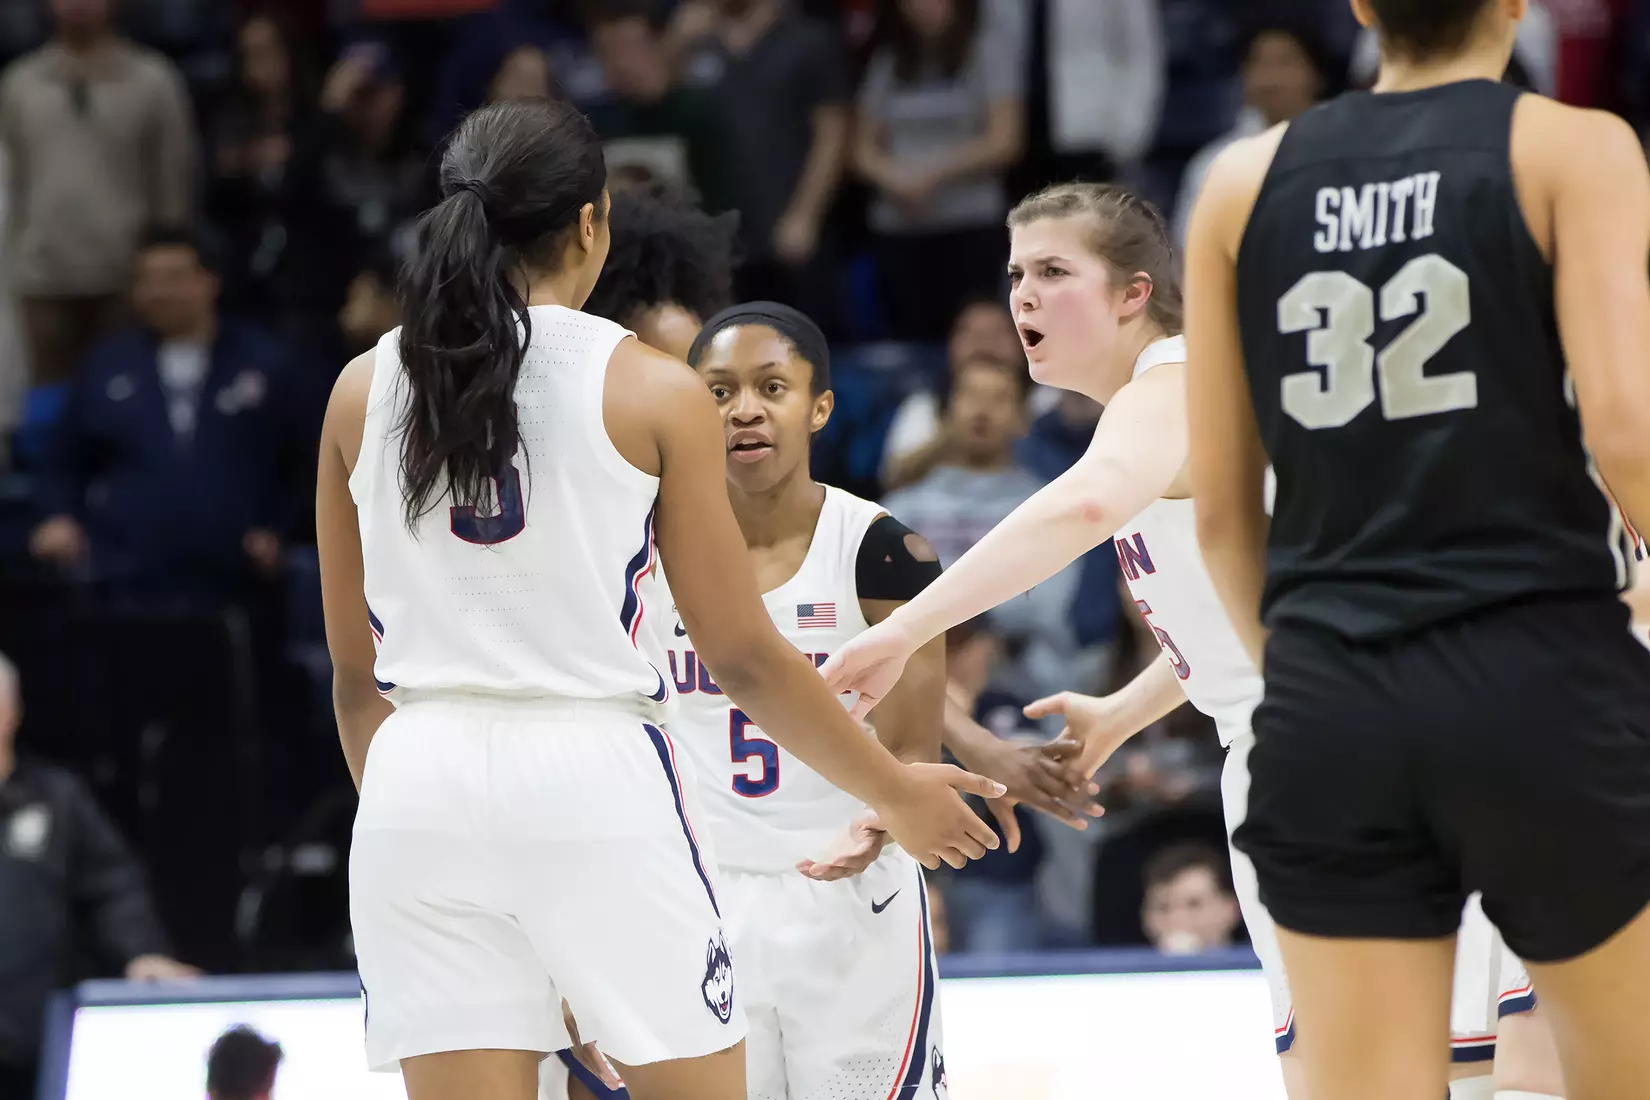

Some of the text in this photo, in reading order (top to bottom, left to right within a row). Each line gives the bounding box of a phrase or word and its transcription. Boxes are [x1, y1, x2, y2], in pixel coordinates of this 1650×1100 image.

[1314, 171, 1440, 252] SMITH
[1277, 253, 1478, 430] 32
[729, 708, 780, 798] 5
